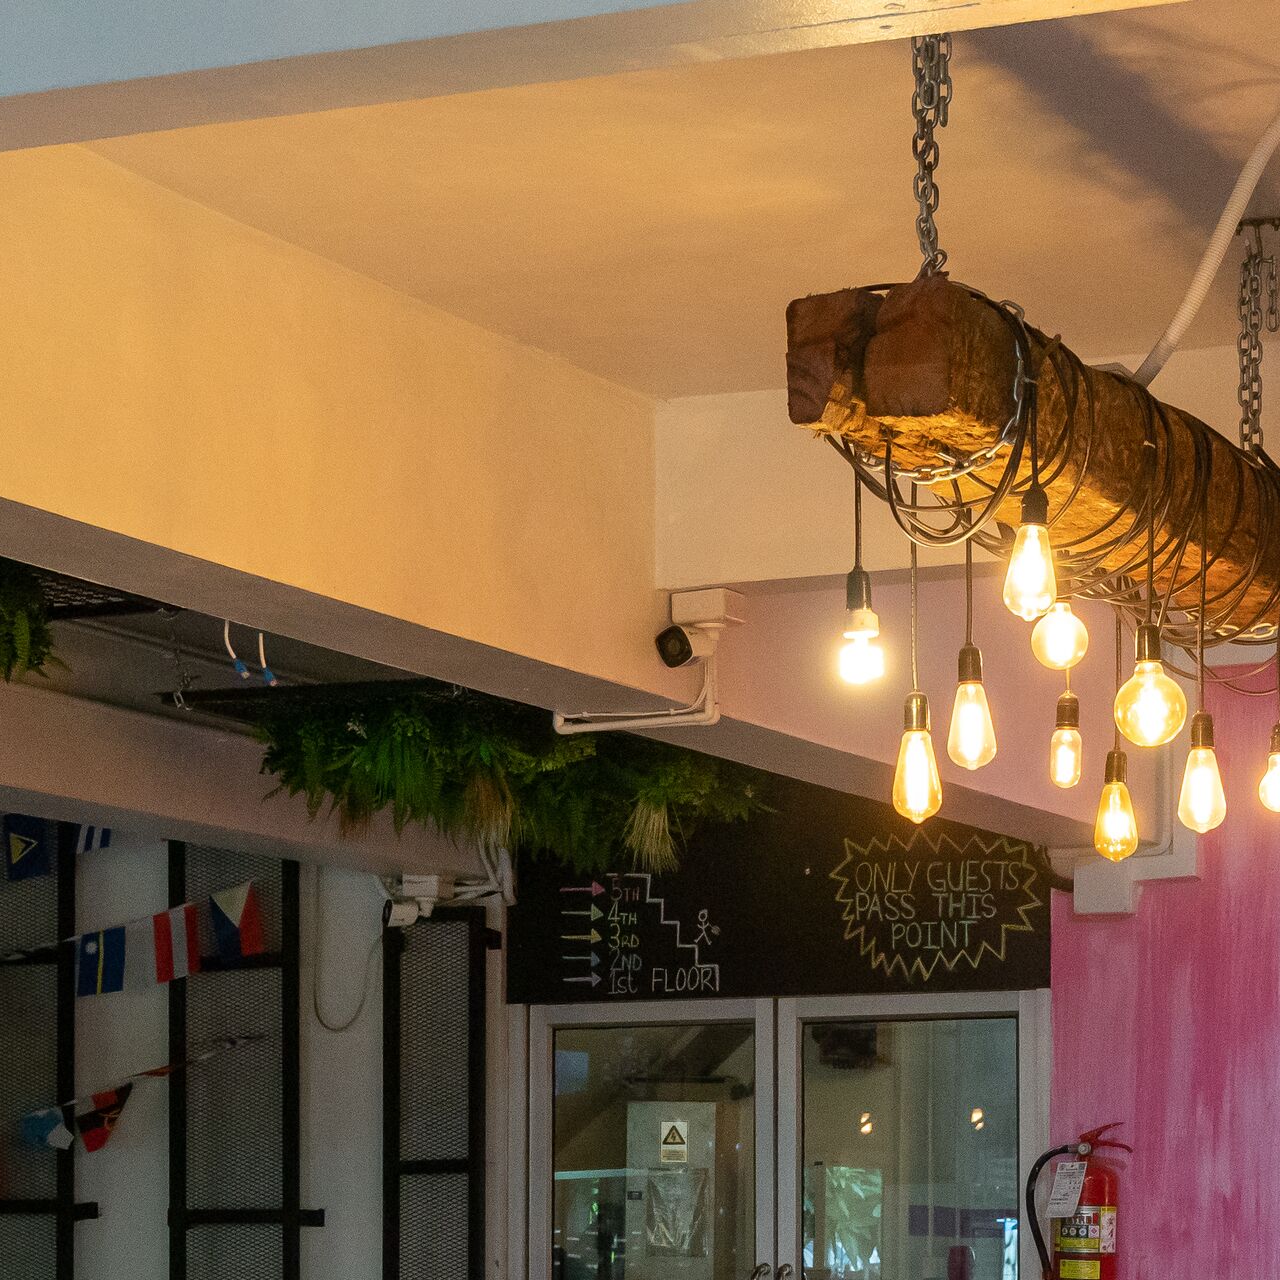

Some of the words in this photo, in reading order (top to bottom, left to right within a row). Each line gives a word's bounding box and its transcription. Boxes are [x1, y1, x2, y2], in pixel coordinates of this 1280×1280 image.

[609, 876, 640, 901] 5TH
[855, 861, 920, 893] ONLY
[927, 860, 1021, 893] GUESTS
[608, 901, 637, 925] 4TH
[856, 892, 916, 921] PASS
[931, 892, 997, 919] THIS
[608, 923, 639, 948] 3RD
[891, 920, 978, 949] POINT
[610, 947, 642, 971] 2ND
[651, 966, 714, 992] FLOOR
